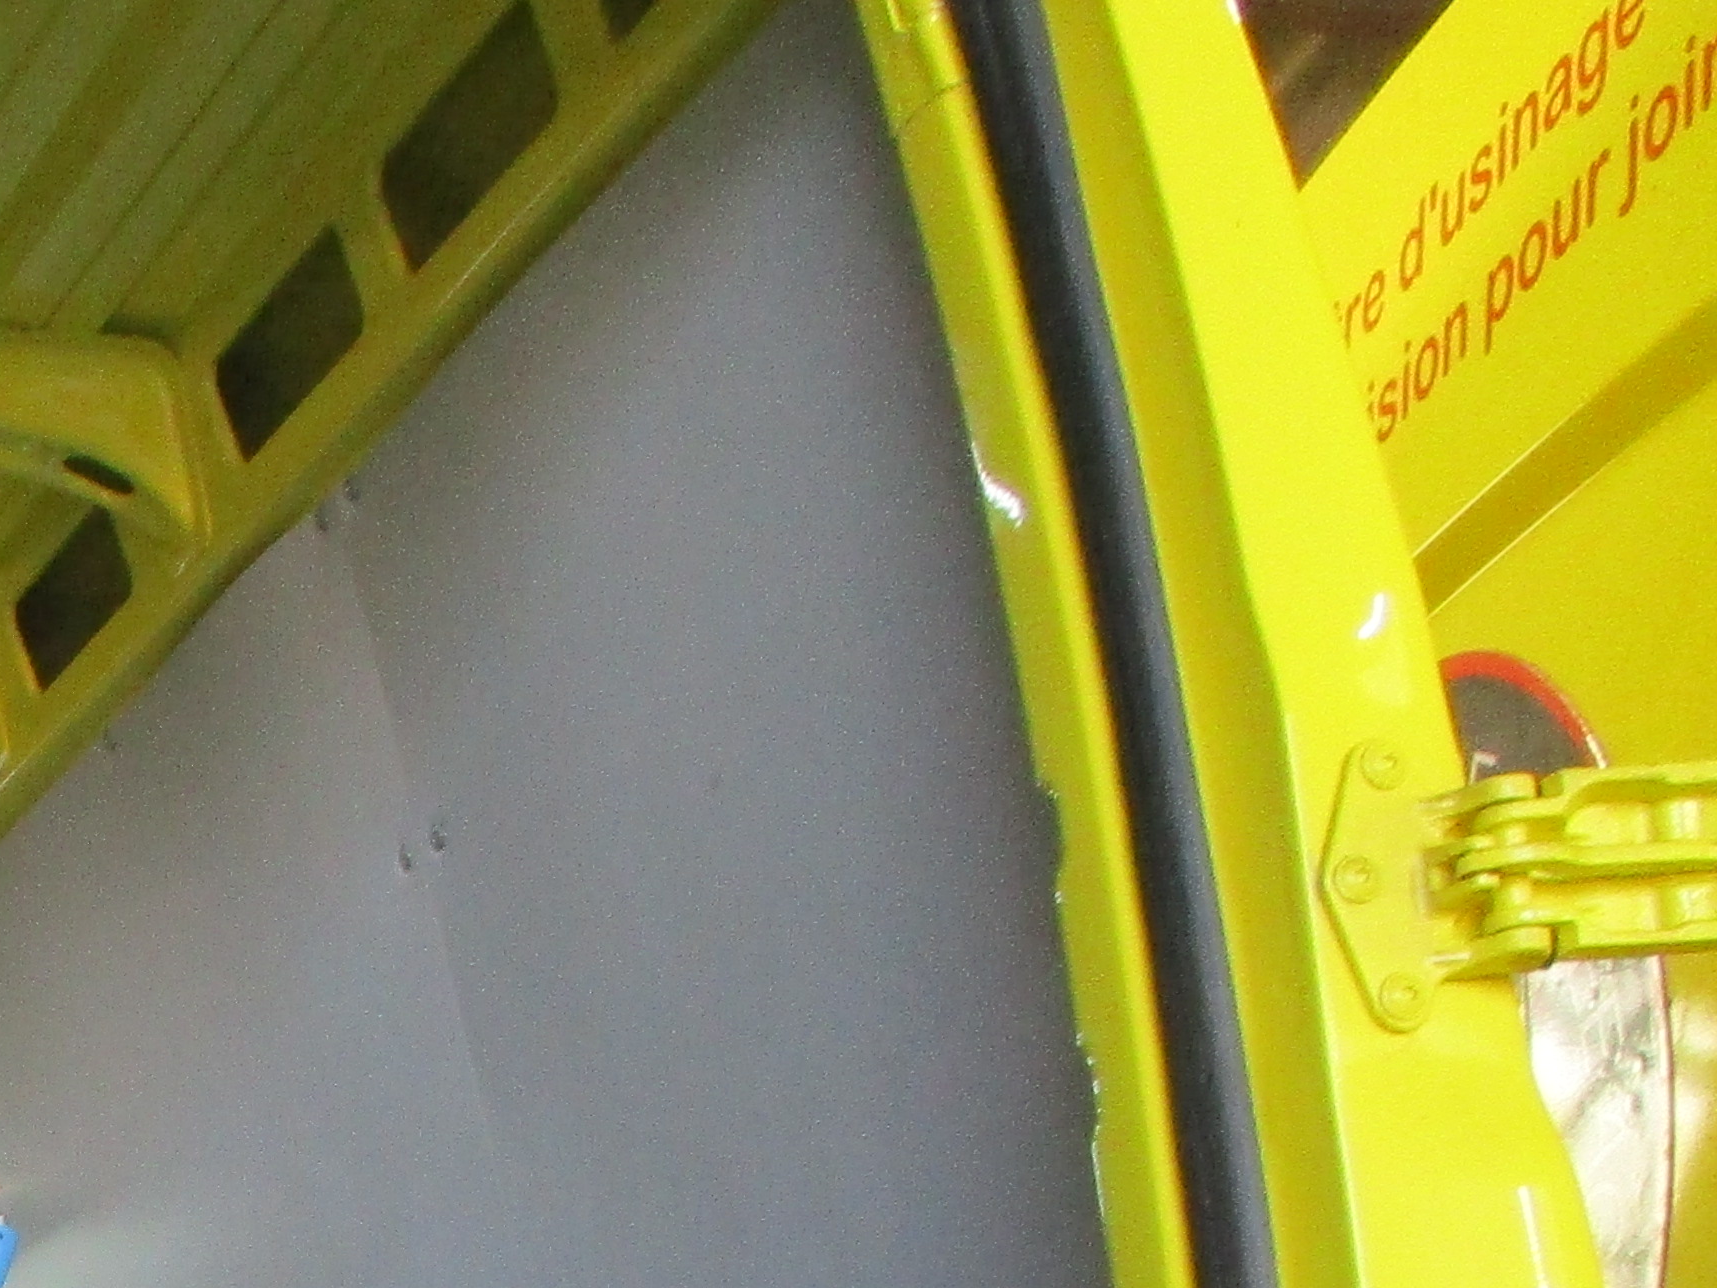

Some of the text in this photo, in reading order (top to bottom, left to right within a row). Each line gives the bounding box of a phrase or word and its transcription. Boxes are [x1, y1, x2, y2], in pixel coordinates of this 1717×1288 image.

[1333, 0, 1646, 350] re d'usinage
[1484, 148, 1611, 355] pour
